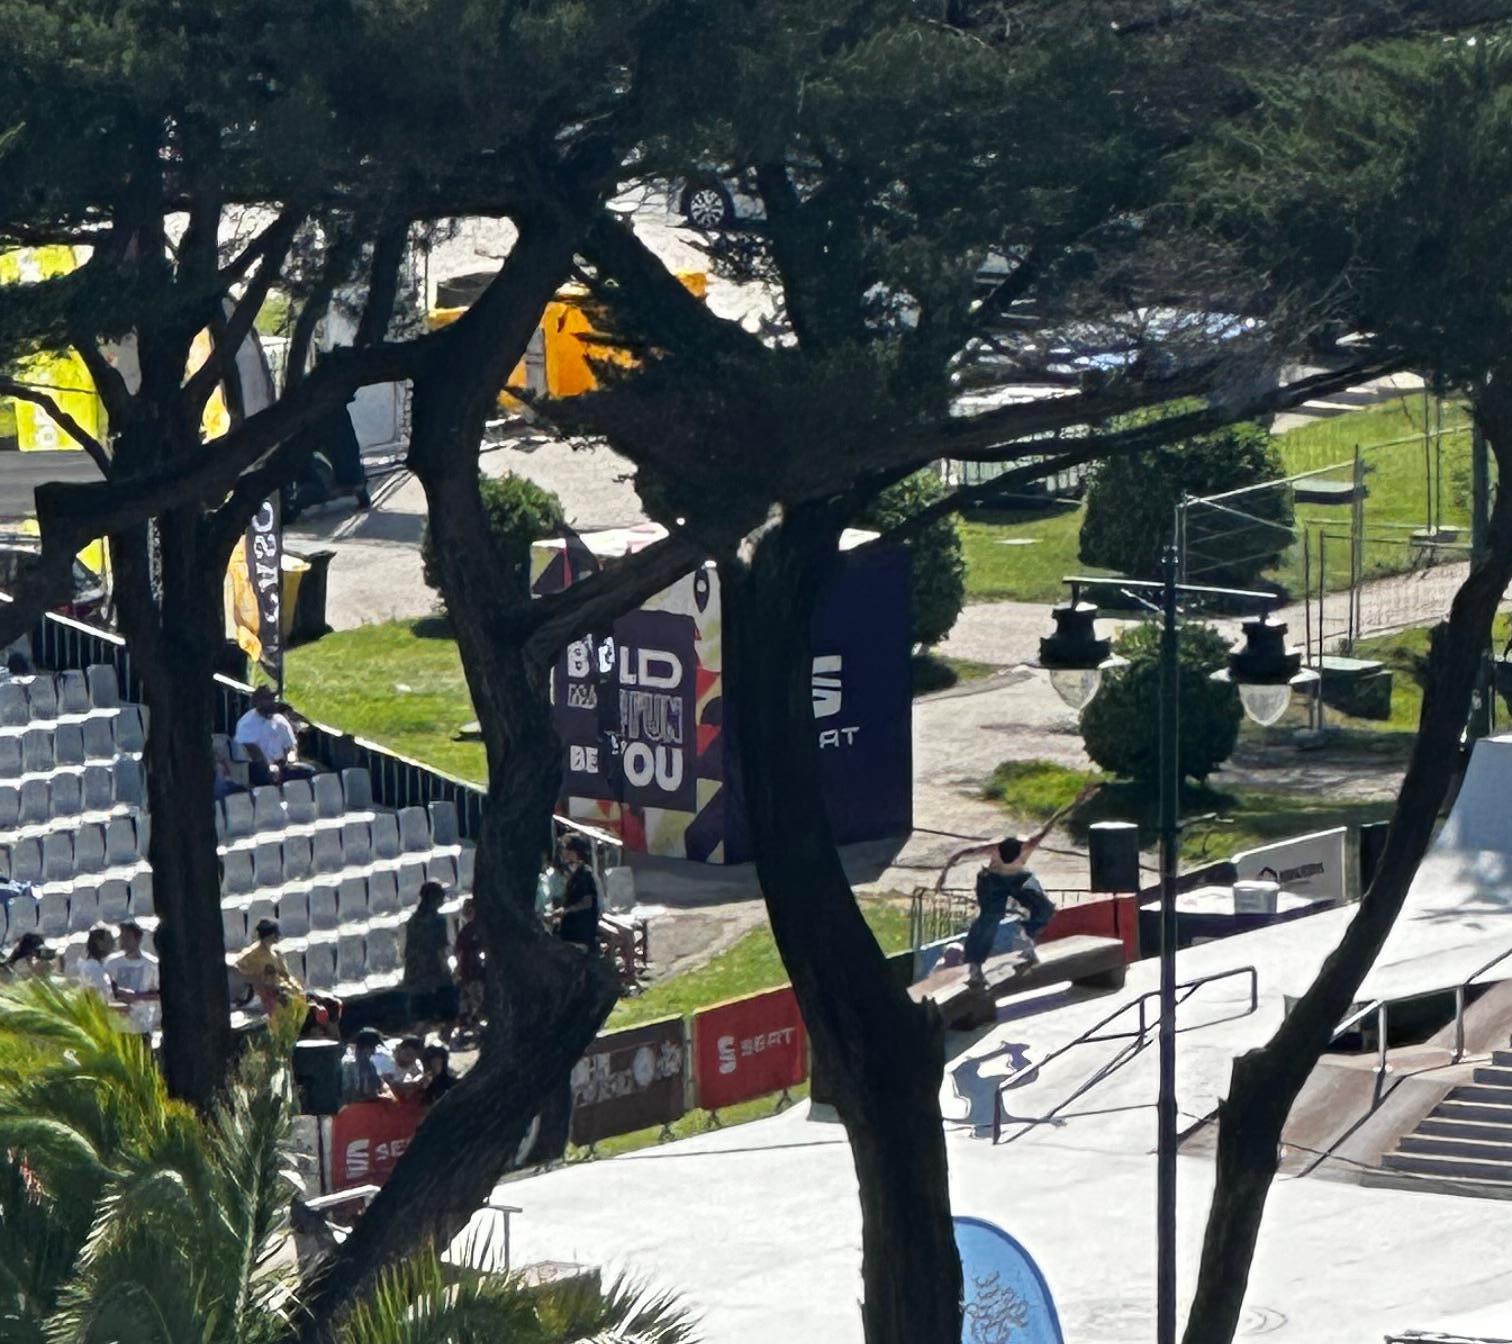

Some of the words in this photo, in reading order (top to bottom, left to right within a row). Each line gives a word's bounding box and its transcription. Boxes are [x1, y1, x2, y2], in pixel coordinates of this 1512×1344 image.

[818, 726, 861, 750] AT
[569, 745, 599, 773] BE
[613, 736, 684, 792] OU
[740, 1027, 796, 1057] SEAT
[375, 1137, 411, 1161] SE
